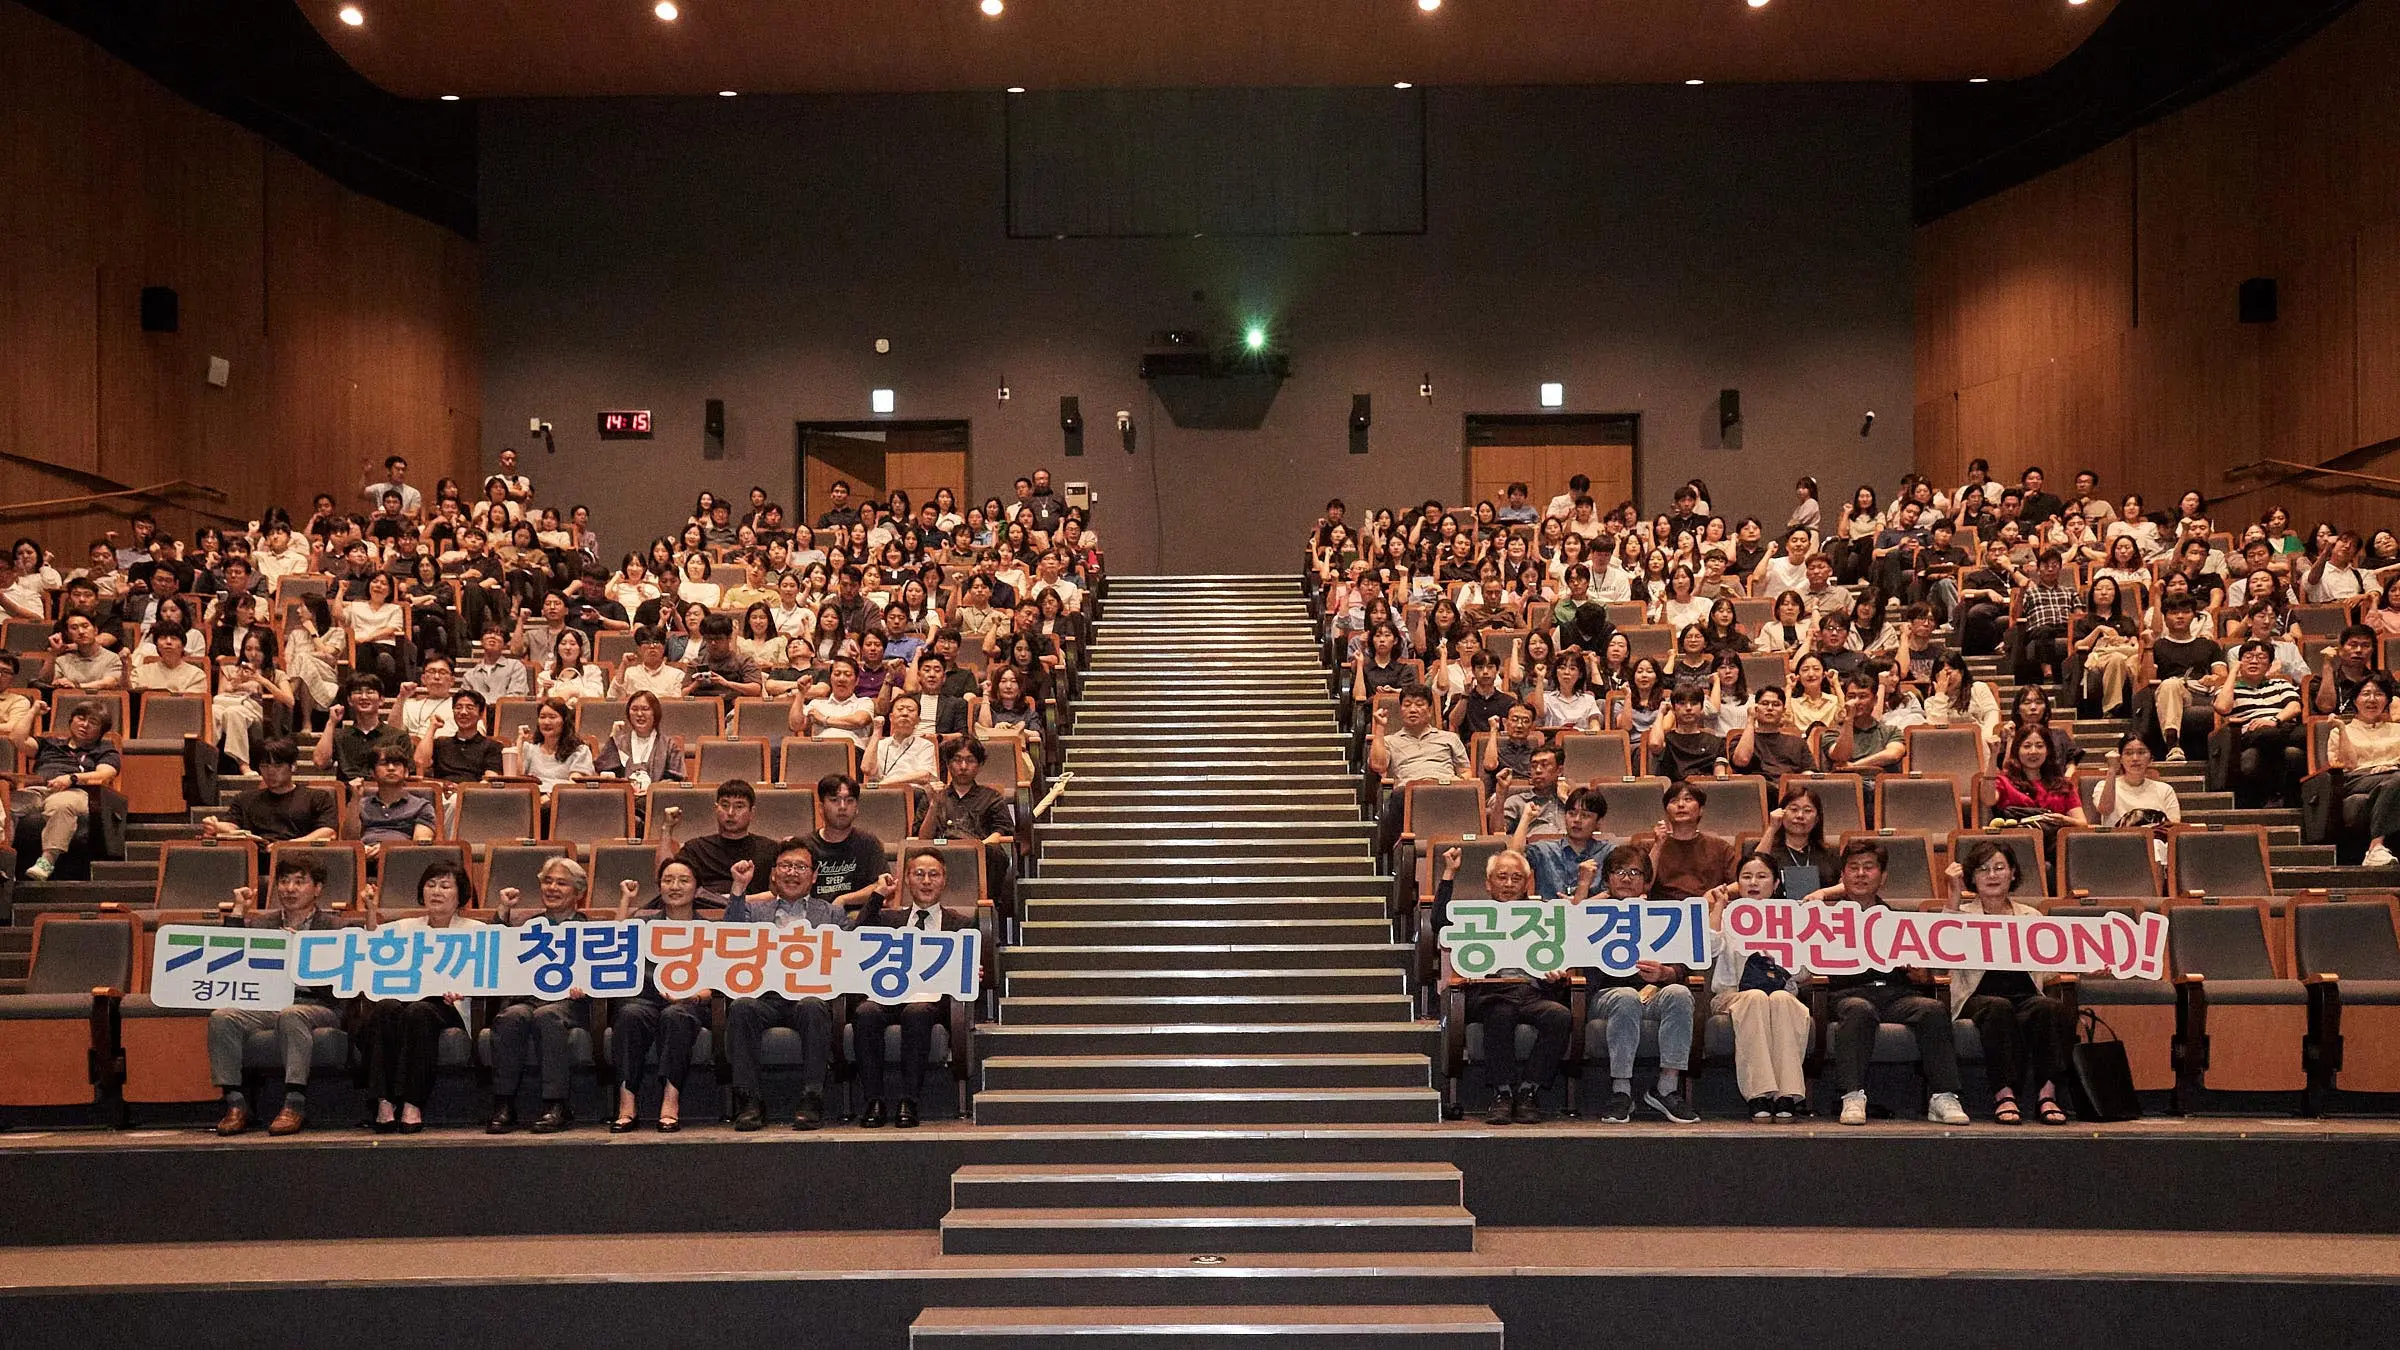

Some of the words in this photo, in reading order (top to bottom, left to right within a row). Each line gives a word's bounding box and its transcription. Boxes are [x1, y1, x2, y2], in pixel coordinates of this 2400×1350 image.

[606, 413, 648, 431] 14:15
[298, 929, 500, 995] 다함께
[517, 924, 639, 993] 청렴
[650, 926, 842, 994] 당당한
[859, 933, 974, 998] 경기
[1447, 905, 1566, 973] 공정
[1586, 904, 1704, 970] 경기
[1730, 904, 2161, 972] 액션(ACTION)!
[191, 980, 261, 1001] 경기도
